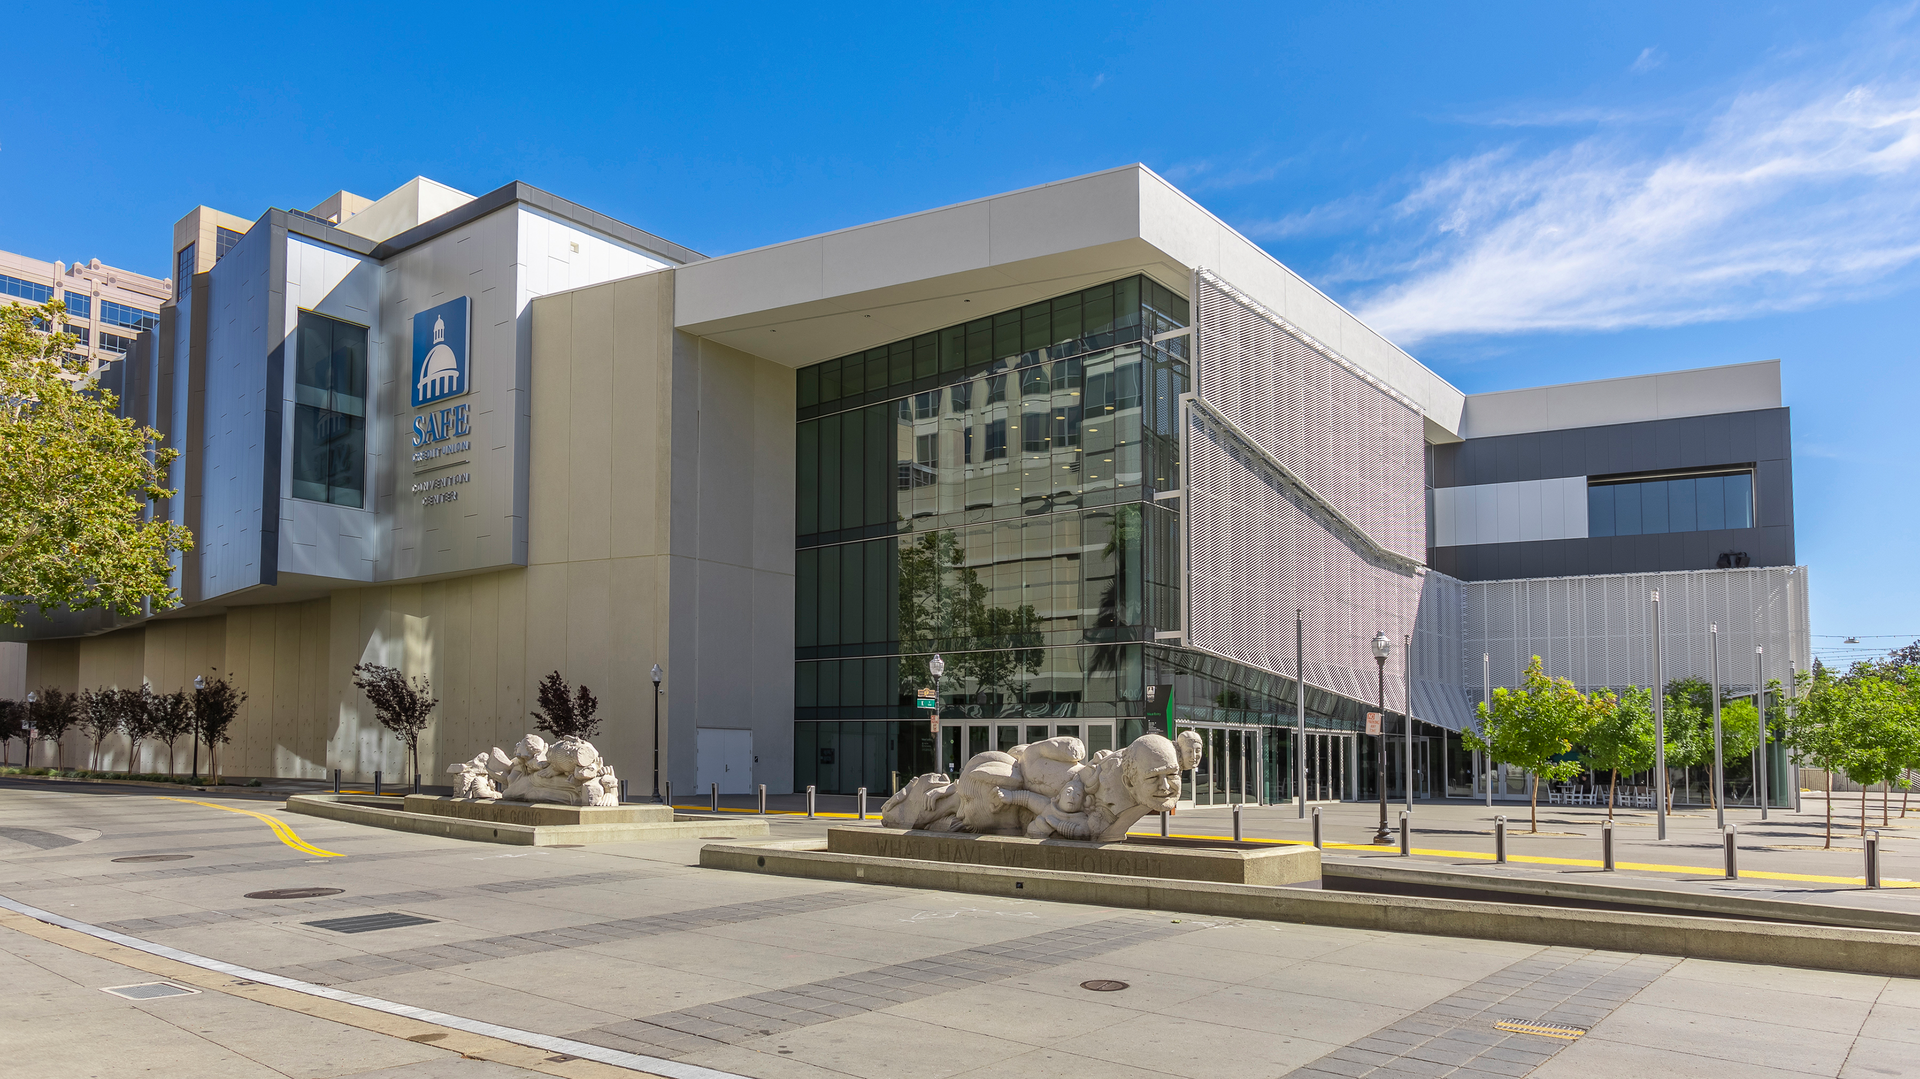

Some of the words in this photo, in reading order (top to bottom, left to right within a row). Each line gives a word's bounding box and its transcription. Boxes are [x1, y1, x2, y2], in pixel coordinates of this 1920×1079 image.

[412, 403, 470, 447] SAFE
[412, 447, 441, 462] CREDIT
[441, 440, 470, 455] UNION
[412, 472, 470, 493] CONVENTION
[422, 490, 458, 506] CENTER
[510, 809, 541, 825] GOING
[876, 838, 923, 859] WHAT
[938, 843, 985, 864] HAVE
[1049, 851, 1164, 877] THOUGHT
